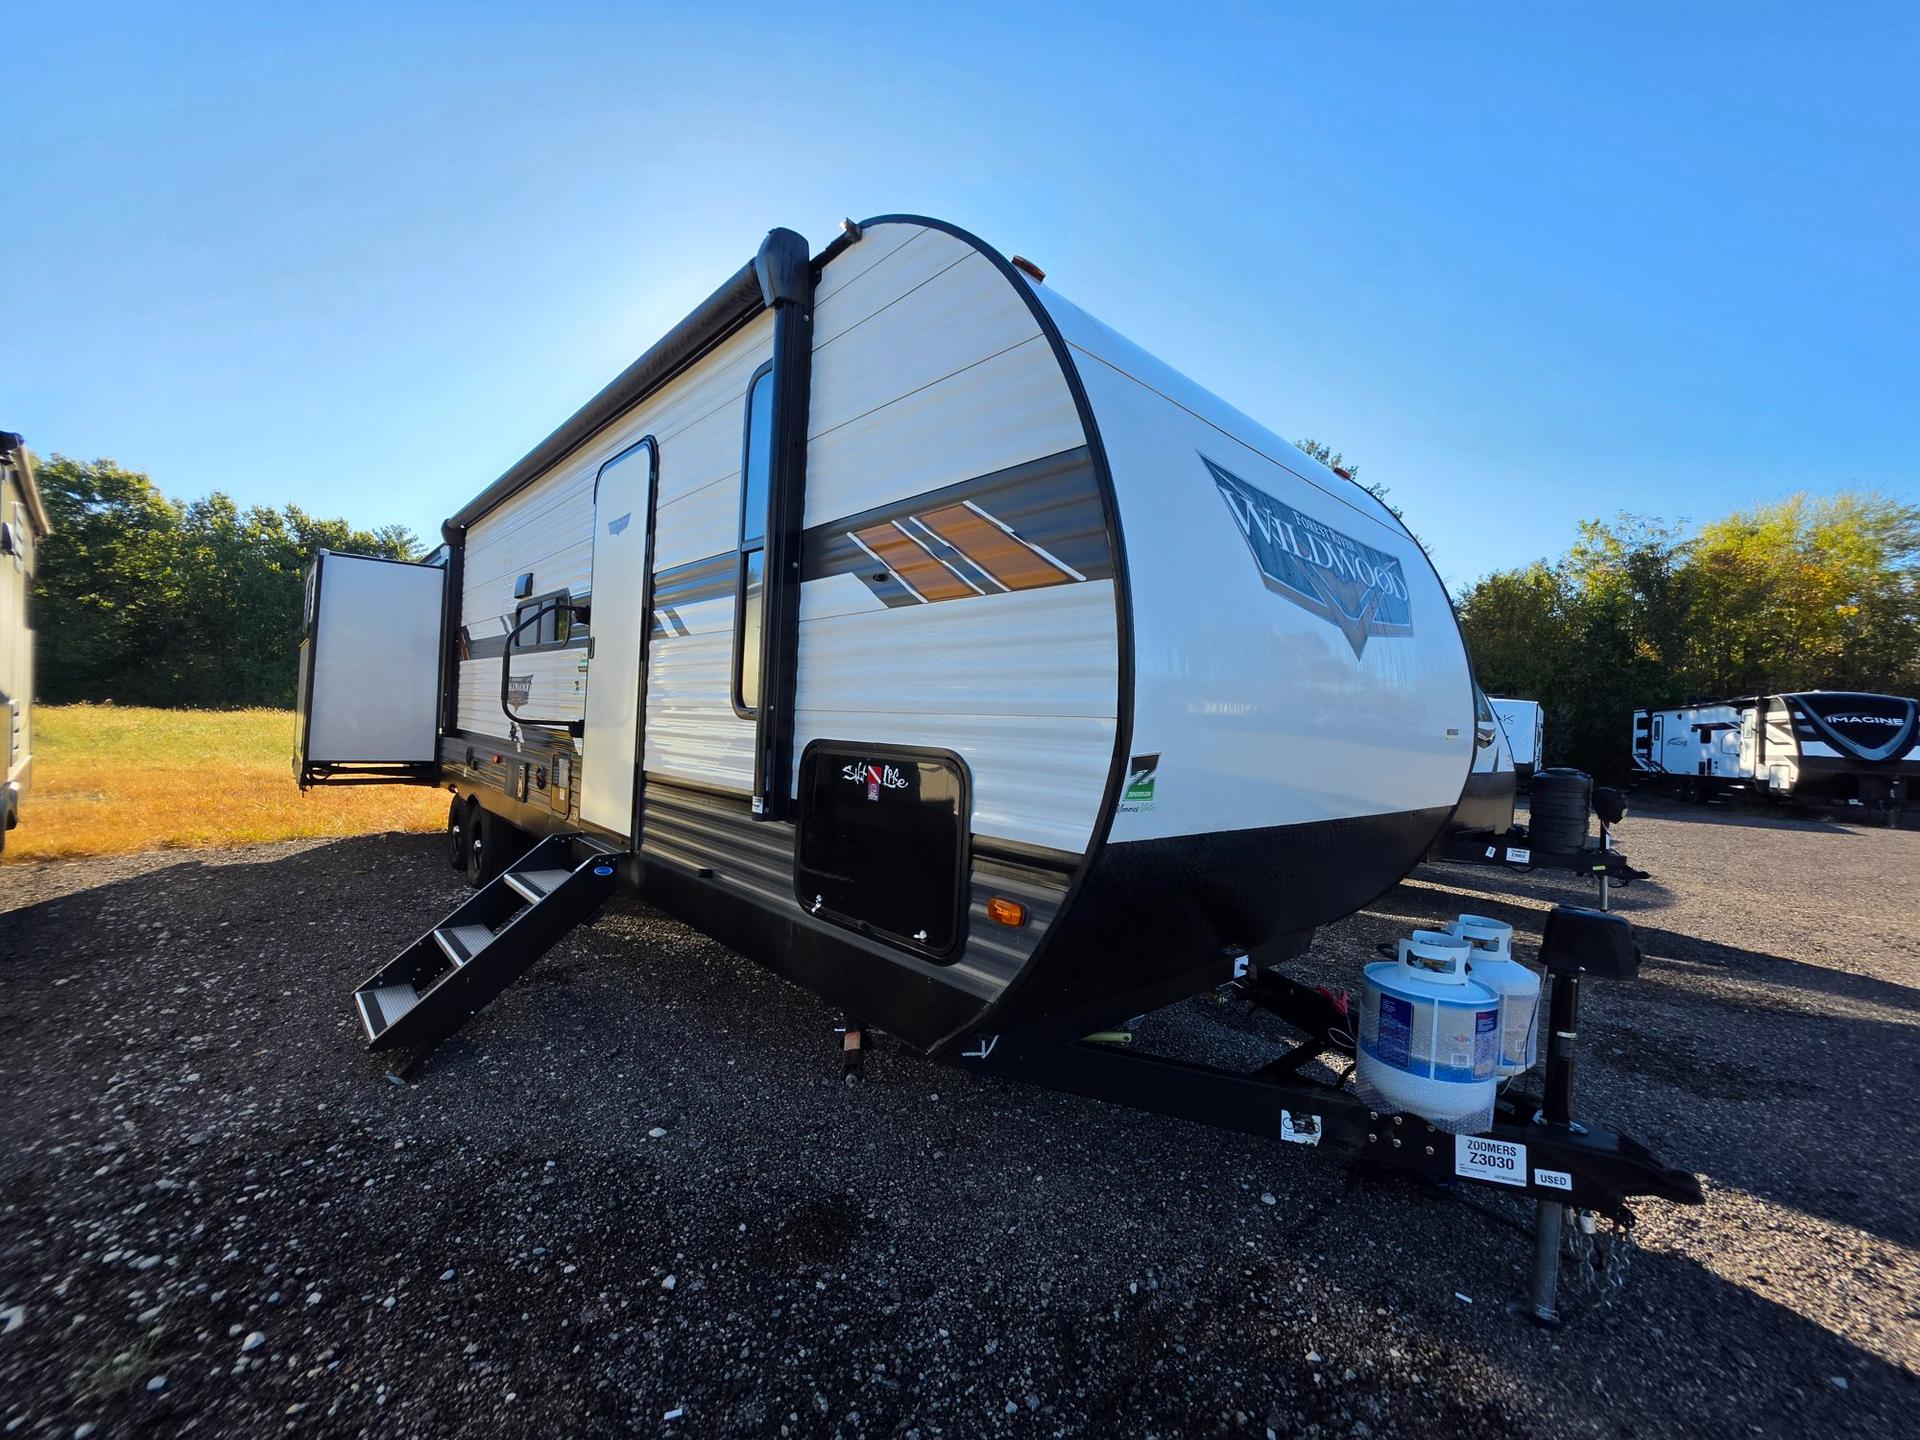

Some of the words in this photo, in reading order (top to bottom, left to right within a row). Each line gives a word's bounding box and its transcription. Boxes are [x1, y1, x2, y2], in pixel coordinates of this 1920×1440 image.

[1216, 484, 1408, 601] WILDWOOD
[1827, 716, 1905, 726] IMAGINE
[882, 765, 908, 788] Life
[1467, 1139, 1517, 1157] ZOOMERS
[1469, 1152, 1515, 1170] Z3030
[1540, 1174, 1567, 1186] USED
